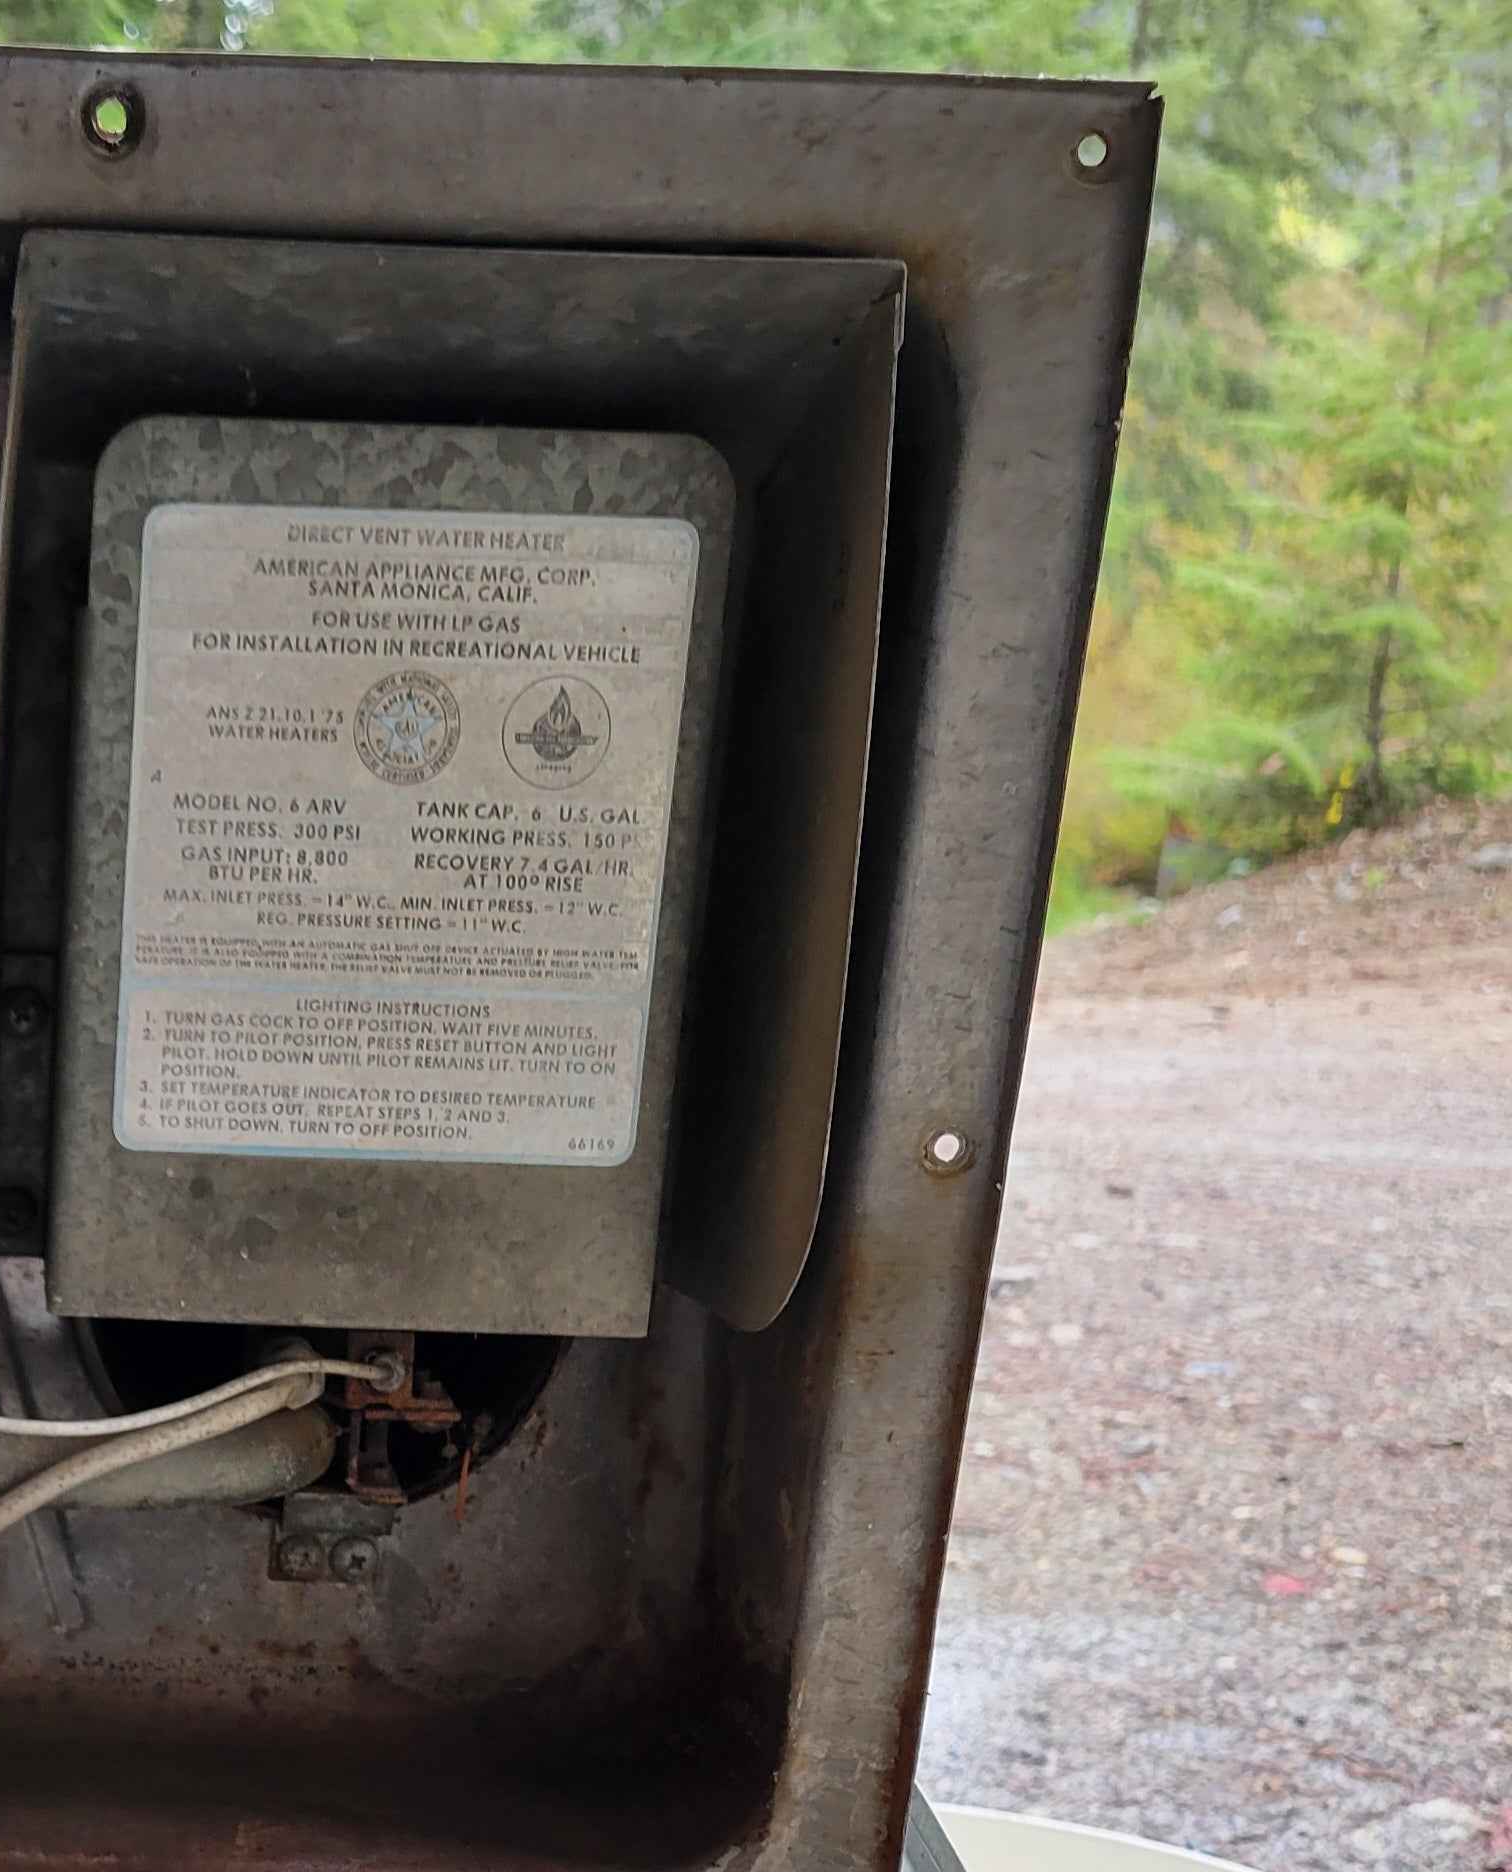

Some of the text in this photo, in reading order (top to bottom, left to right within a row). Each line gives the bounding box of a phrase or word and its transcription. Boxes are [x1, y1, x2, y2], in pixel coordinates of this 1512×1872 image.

[288, 525, 565, 552] DIRECT VENT WATER HEATER
[253, 558, 358, 577] AMERICAN
[366, 561, 474, 582] APPLIANCE
[309, 579, 375, 598] SANTA
[312, 610, 520, 634] FOR USE WITH LP GAS
[193, 632, 640, 664] FOR INSTALLATION IN RECREATIONAL VEHICLE
[206, 706, 238, 720] ANS
[209, 724, 337, 743] WATER HEATERS
[173, 793, 240, 811] MODEL
[290, 797, 299, 813] 6
[306, 798, 346, 815] ARV
[417, 801, 469, 819] TANK
[532, 806, 541, 822] 6
[177, 817, 217, 835] TEST
[294, 823, 327, 840] 300
[334, 824, 360, 841] PSI
[411, 827, 505, 845] WORKING
[585, 831, 615, 850] 150
[181, 845, 221, 862] GAS
[228, 847, 290, 865] INPUT:
[414, 853, 514, 871] RECOVERY
[209, 865, 317, 884] BTU PER HR.
[464, 873, 487, 890] AT
[546, 876, 583, 893] RISE
[211, 890, 251, 904] INLET
[442, 897, 483, 912] INLET
[298, 913, 371, 928] PRESSURE
[377, 915, 441, 931] SETTING
[297, 999, 490, 1018] LIGHTING INSTRUCTIONS
[166, 1010, 206, 1025] TURN
[211, 1013, 243, 1027] GAS
[249, 1013, 293, 1029] COCK
[299, 1015, 318, 1030] TO
[324, 1017, 352, 1031] OFF
[443, 1021, 481, 1036] WAIT
[488, 1023, 520, 1037] FIVE
[165, 1028, 204, 1042] TURN
[211, 1030, 230, 1044] TO
[236, 1031, 277, 1045] PILOT
[367, 1036, 411, 1050] PRESS
[416, 1038, 458, 1052] RESET
[464, 1040, 526, 1055] BUTTON
[532, 1043, 567, 1056] AND
[572, 1044, 617, 1059] LIGHT
[215, 1048, 257, 1062] HOLD
[262, 1049, 313, 1064] DOWN
[319, 1052, 361, 1067] UNTIL
[367, 1054, 409, 1068] PILOT
[415, 1056, 484, 1071] REMAINS
[520, 1059, 559, 1073] TURN
[566, 1061, 585, 1074] TO
[591, 1062, 615, 1075] ON
[162, 1081, 185, 1094] SET
[192, 1082, 299, 1098] TEMPERATURE
[304, 1086, 390, 1101] INDICATOR
[396, 1089, 415, 1103] TO
[420, 1090, 482, 1105] DESIRED
[160, 1098, 172, 1111] IF
[178, 1098, 218, 1113] PILOT
[225, 1101, 266, 1114] GOES
[318, 1104, 372, 1119] REPEAT
[378, 1106, 420, 1120] STEPS
[457, 1109, 491, 1123] AND
[160, 1114, 179, 1128] TO
[185, 1117, 222, 1129] SHUT
[290, 1120, 329, 1134] TURN
[335, 1122, 354, 1135] TO
[360, 1123, 388, 1137] OFF
[568, 1137, 614, 1150] 66169
